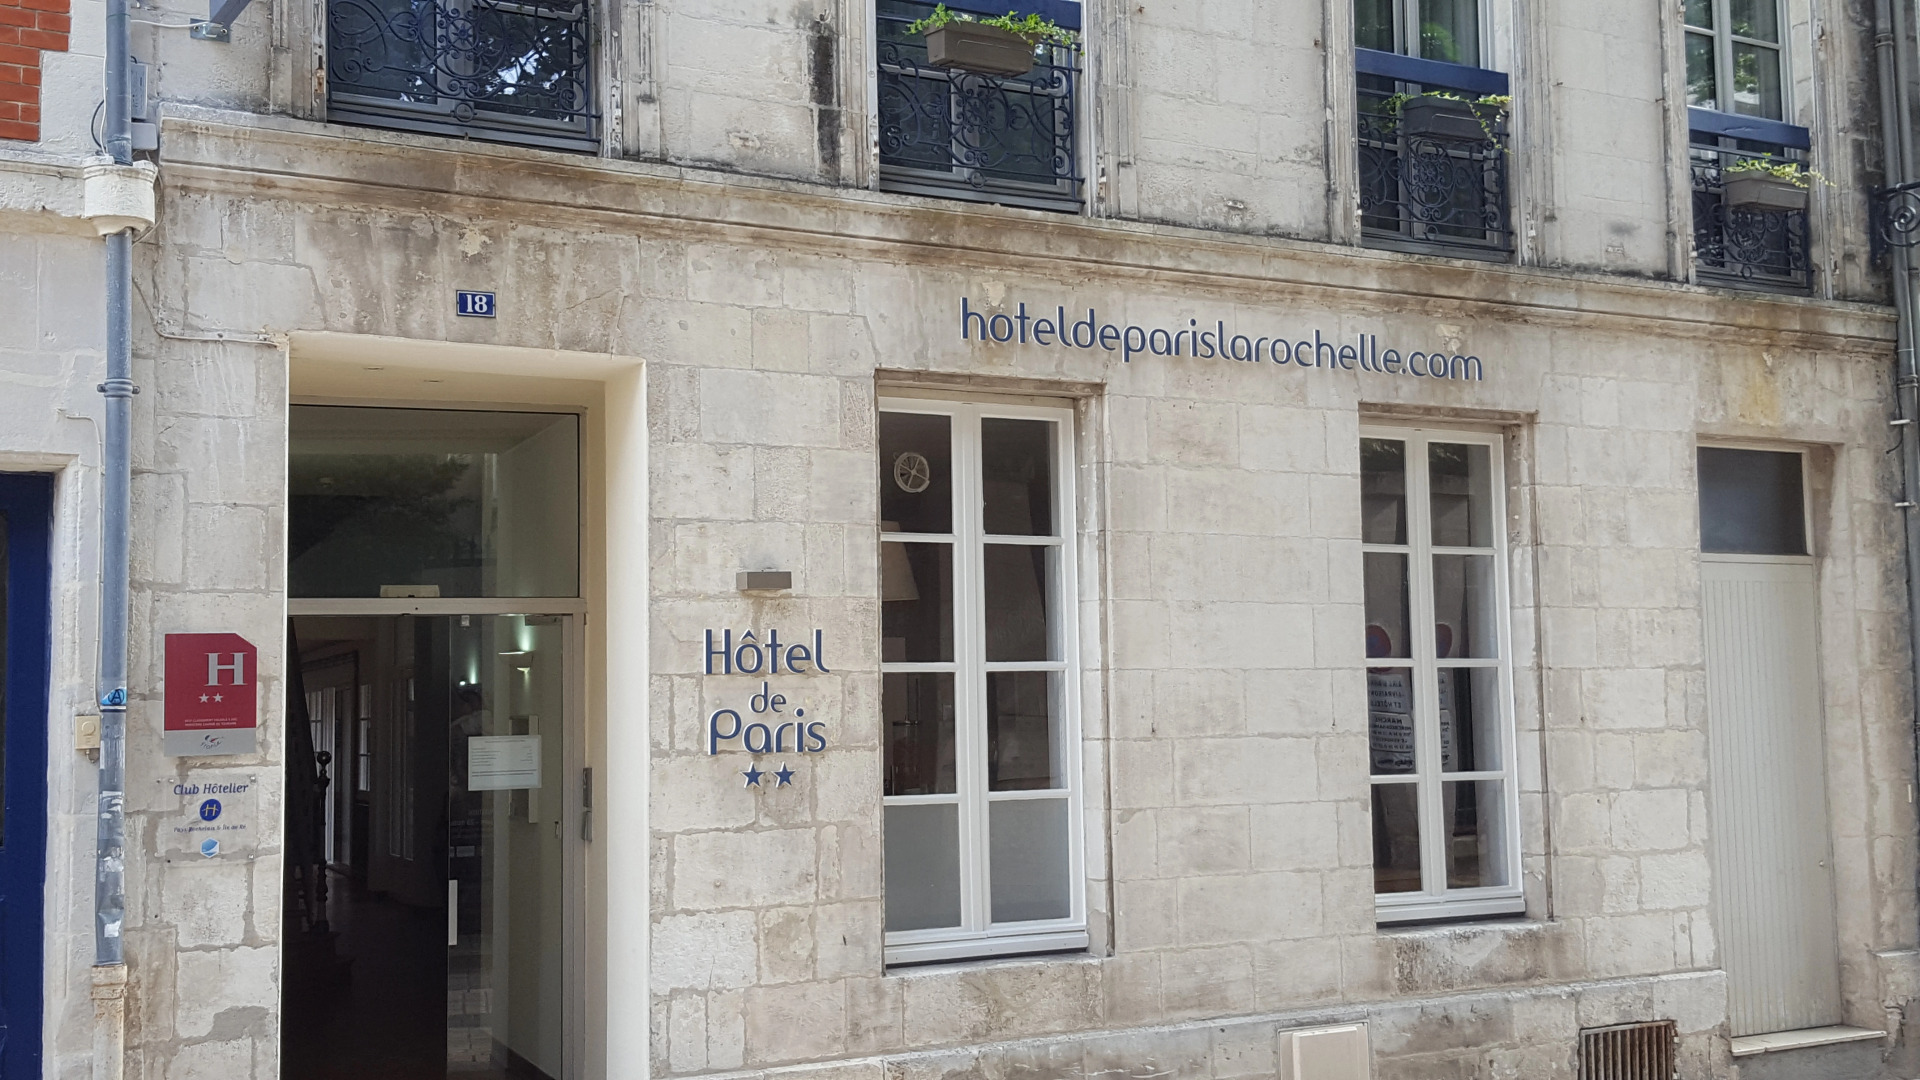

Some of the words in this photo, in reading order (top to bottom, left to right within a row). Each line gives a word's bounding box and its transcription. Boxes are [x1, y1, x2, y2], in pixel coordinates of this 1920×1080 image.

[466, 294, 488, 313] 18
[959, 296, 1483, 382] hoteldeparislarochelle.com
[204, 652, 248, 687] H
[703, 629, 830, 675] Hôtel
[749, 681, 787, 714] de
[707, 708, 827, 755] Paris
[173, 784, 199, 795] Club
[202, 782, 249, 794] Hôtelier
